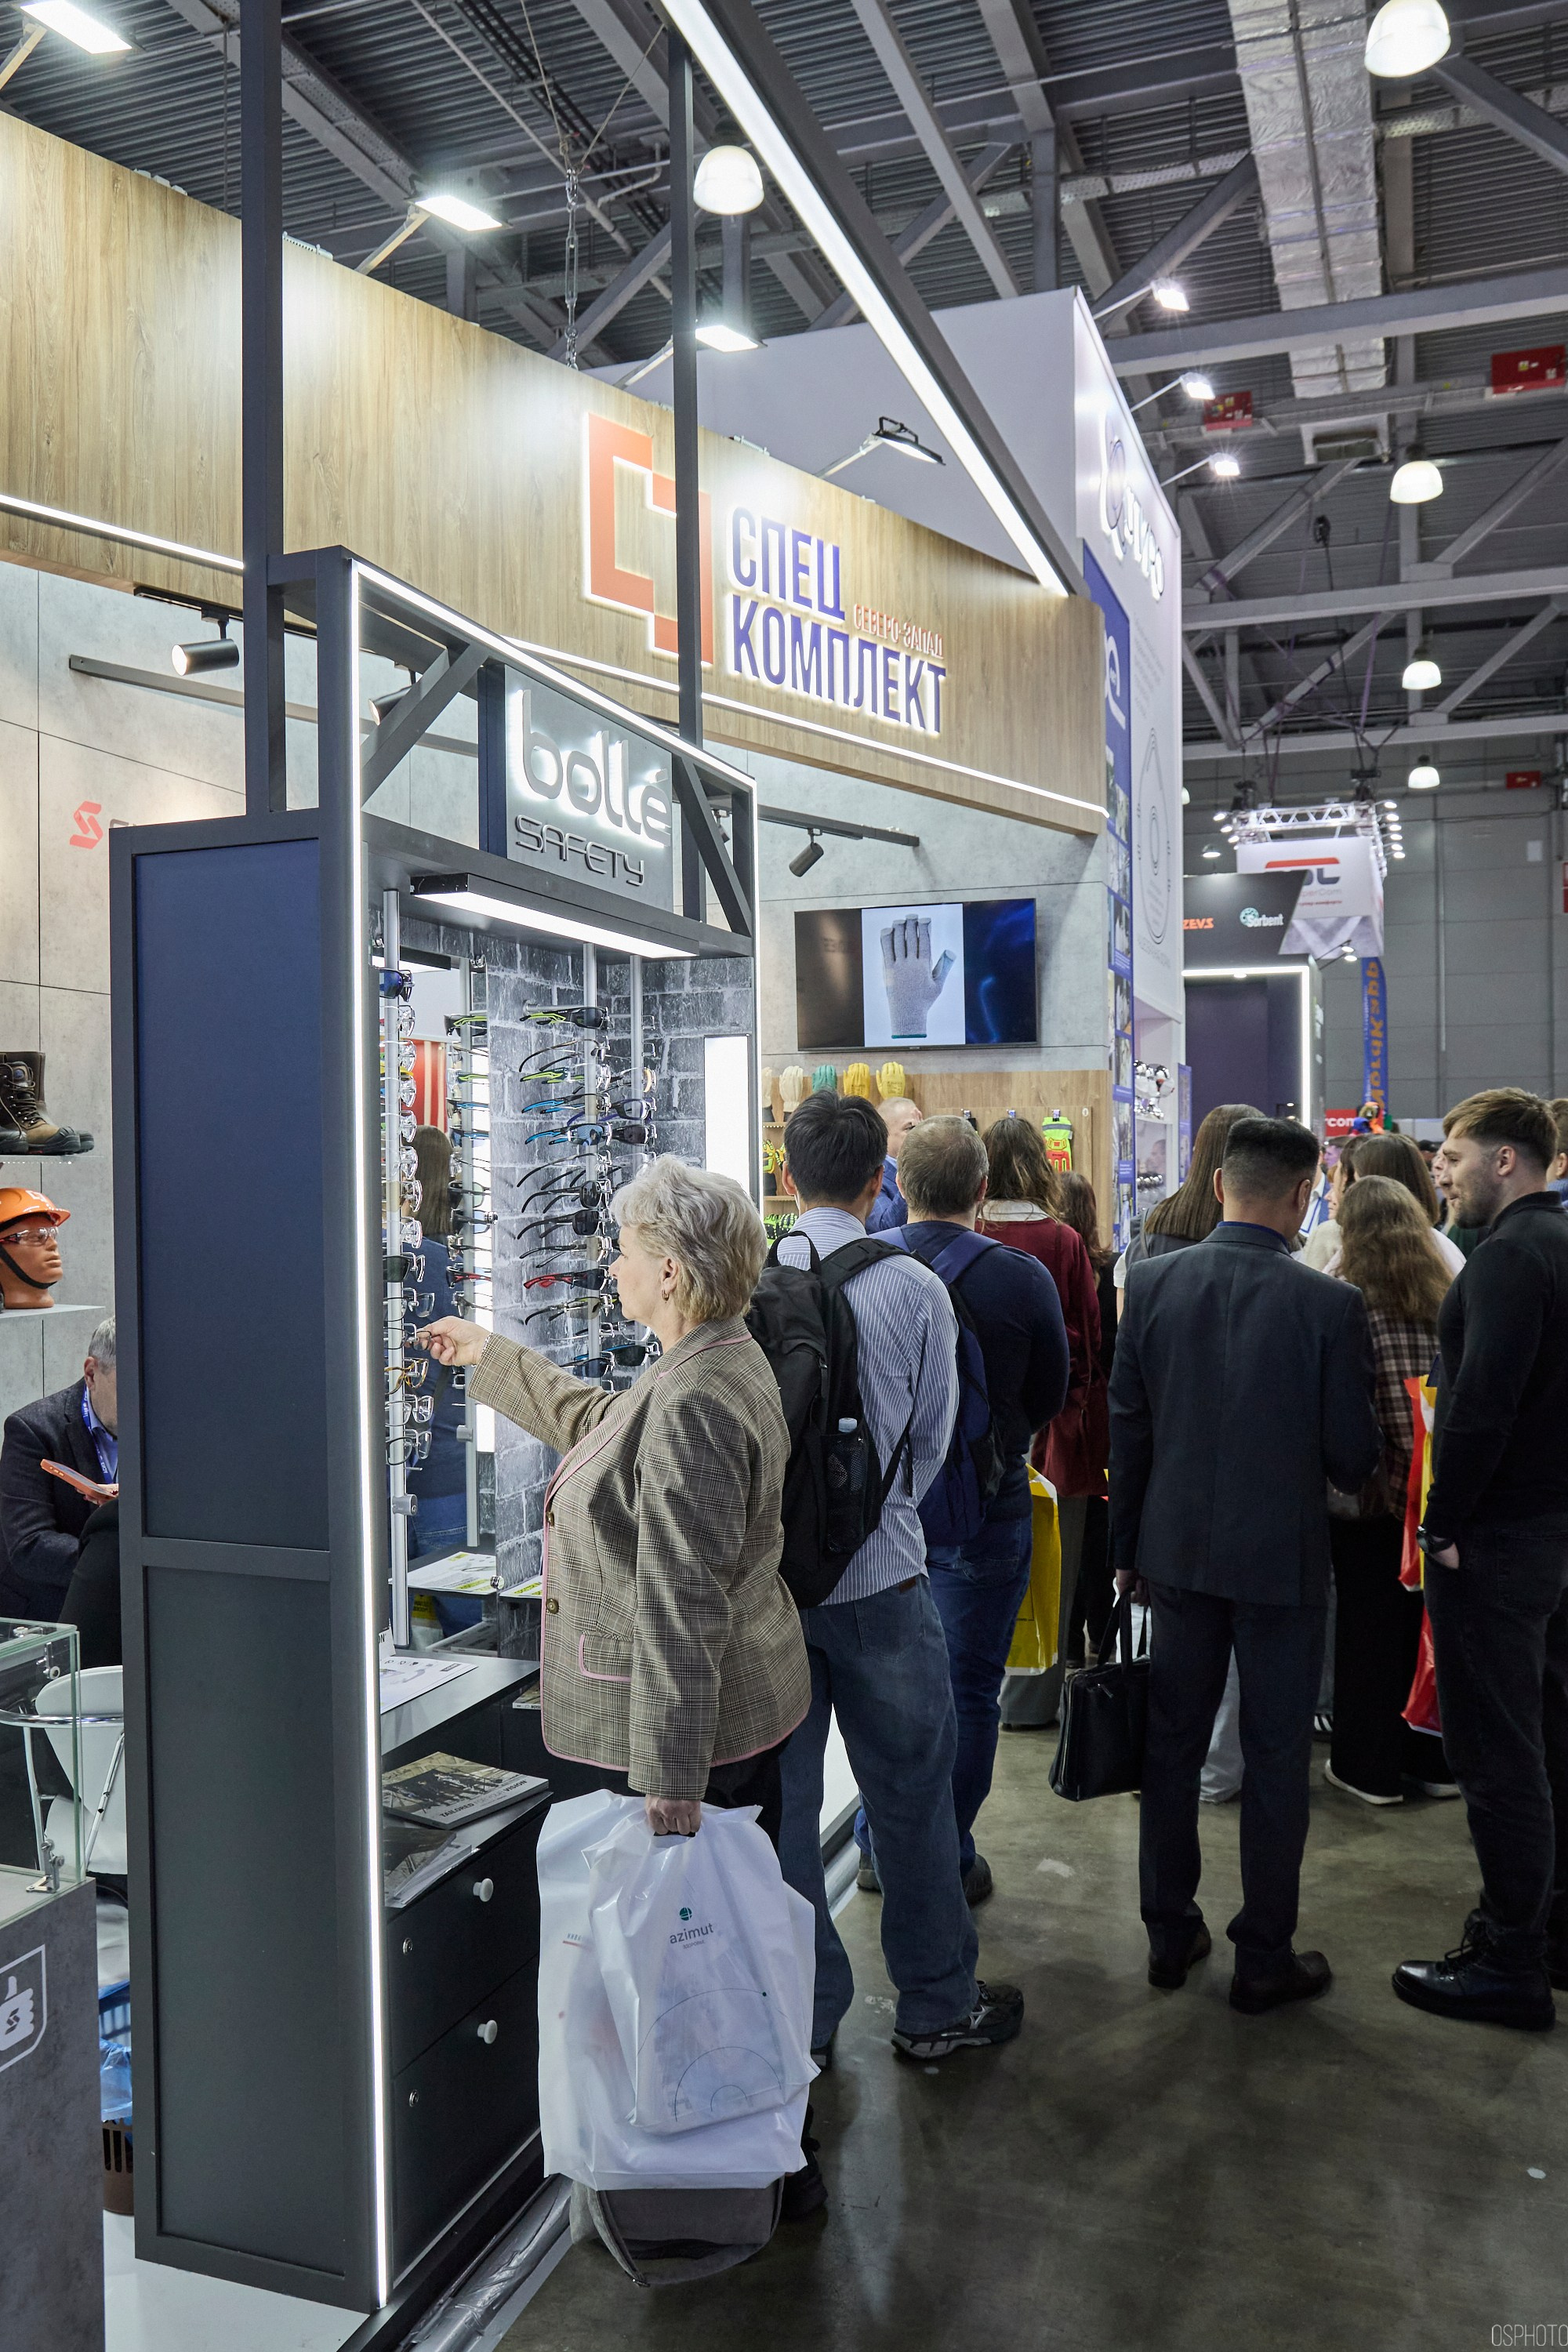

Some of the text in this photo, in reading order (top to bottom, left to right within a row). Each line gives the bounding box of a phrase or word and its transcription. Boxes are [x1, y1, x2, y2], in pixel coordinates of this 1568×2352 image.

[732, 506, 845, 621] СПЕЦ
[853, 603, 944, 659] СЕВЕРО-ЗАПАД
[732, 593, 946, 734] КОМПЛЕКТ
[521, 689, 671, 848] bollé
[515, 814, 645, 887] SAFETY
[1247, 913, 1284, 927] Sorbent
[439, 1802, 474, 1817] TAILORED
[670, 1923, 713, 1944] azimut
